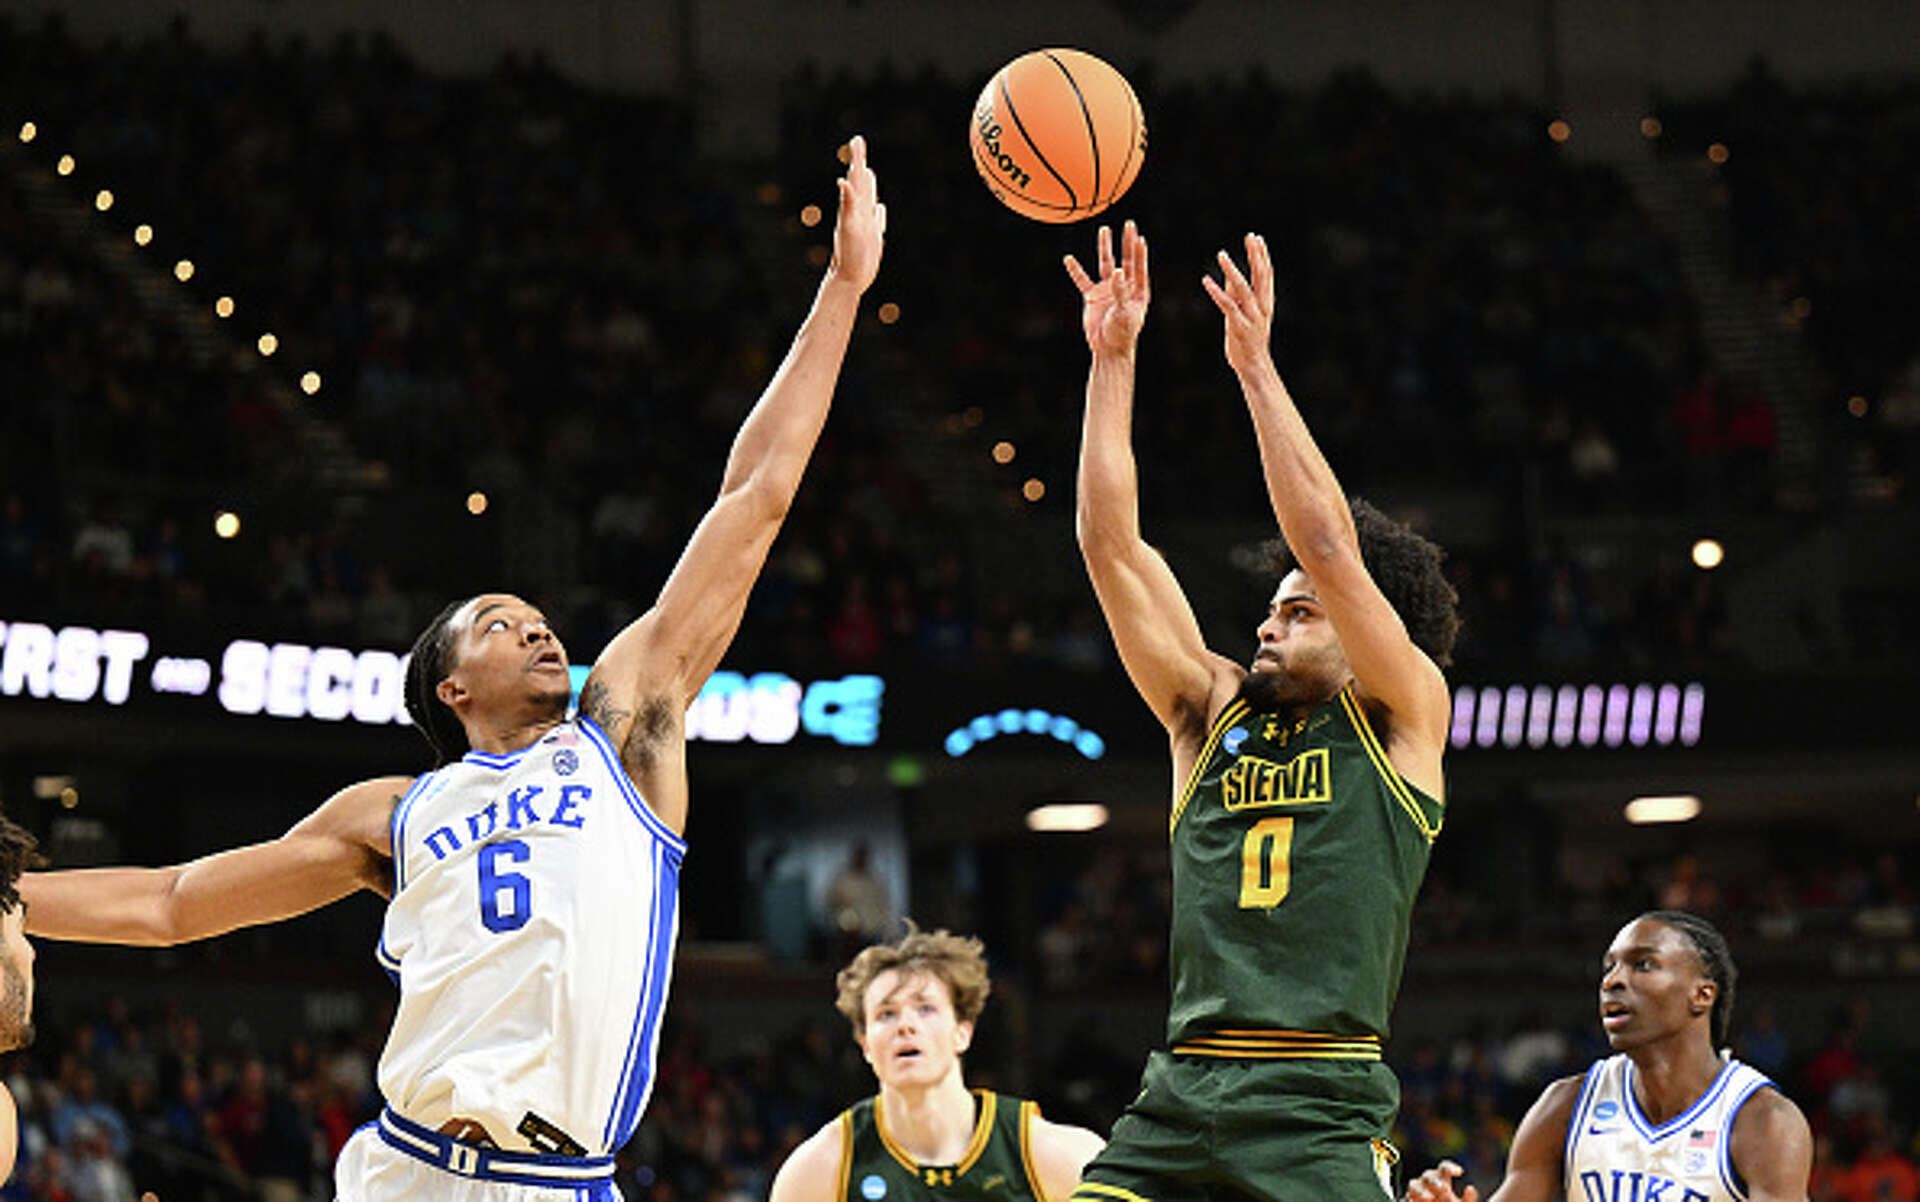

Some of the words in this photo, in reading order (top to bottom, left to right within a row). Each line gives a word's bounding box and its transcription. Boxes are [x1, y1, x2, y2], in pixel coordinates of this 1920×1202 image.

[978, 106, 1031, 189] ilson
[1222, 749, 1331, 811] SIENA
[424, 785, 592, 860] DUKE
[1238, 816, 1294, 909] 0
[477, 839, 532, 934] 6
